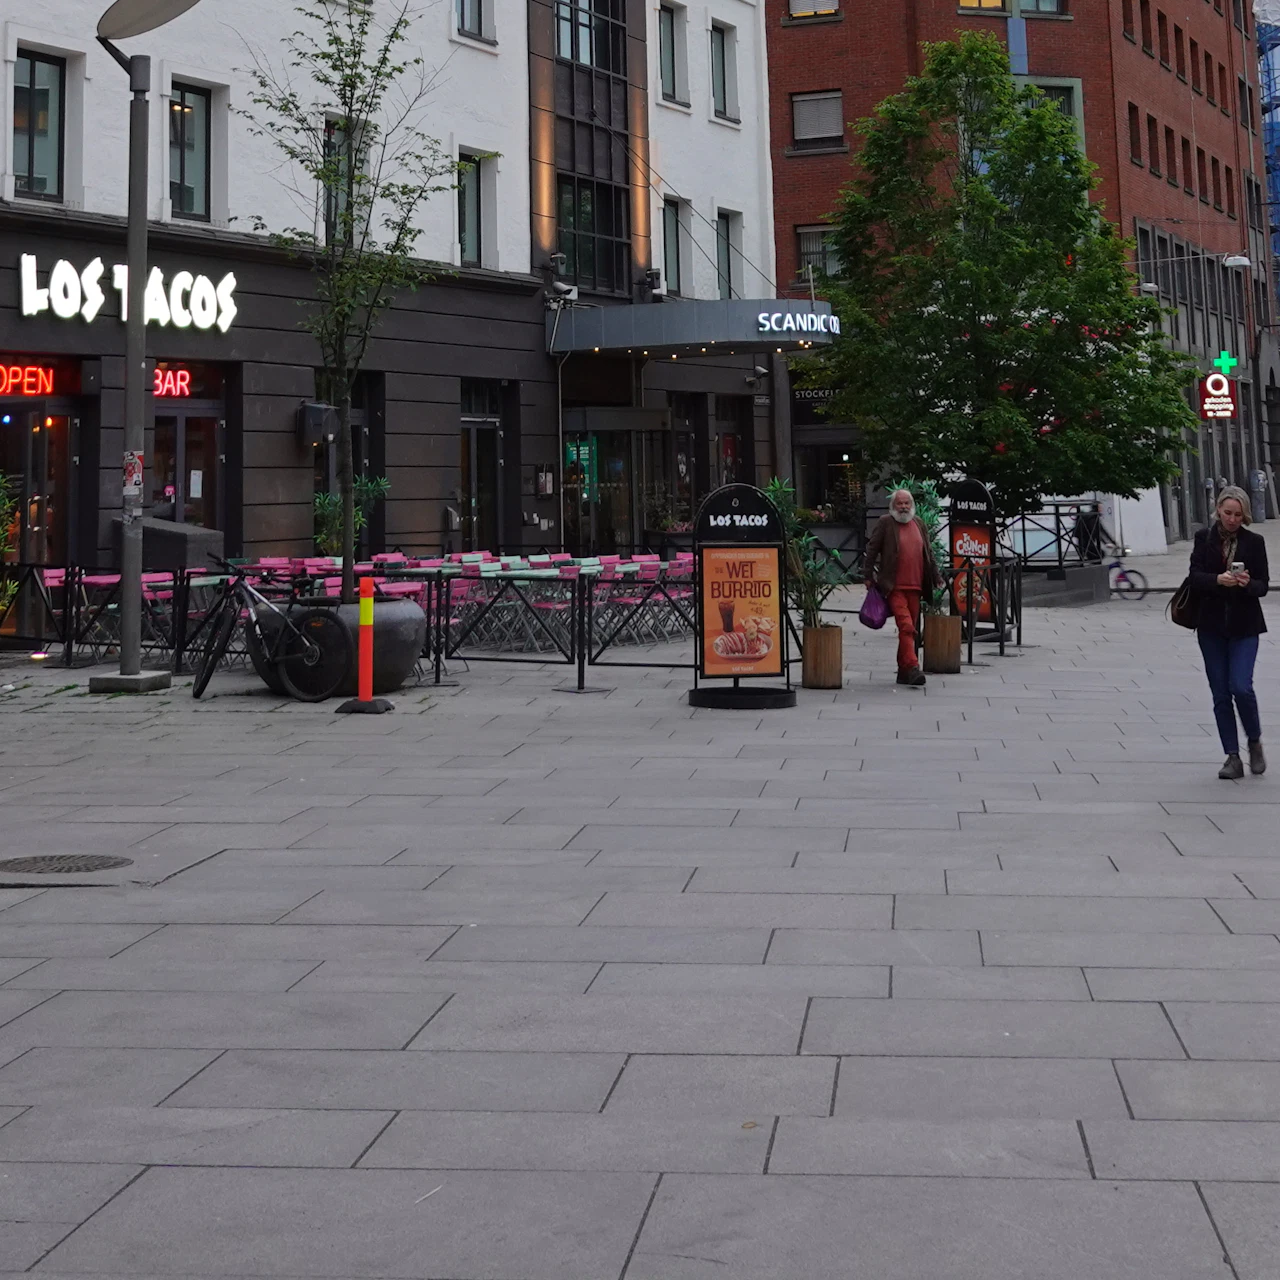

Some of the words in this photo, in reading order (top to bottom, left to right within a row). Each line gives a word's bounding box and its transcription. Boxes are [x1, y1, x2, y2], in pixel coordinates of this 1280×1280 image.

[21, 253, 105, 323] LOS
[113, 264, 237, 333] TACOS
[758, 313, 828, 332] SCANDIC
[153, 368, 190, 397] BAR
[957, 500, 969, 510] LOS
[969, 501, 987, 511] TACOS
[709, 513, 731, 527] LOS
[733, 513, 768, 527] TACOS
[726, 561, 756, 579] WET
[711, 580, 772, 599] BURRITO
